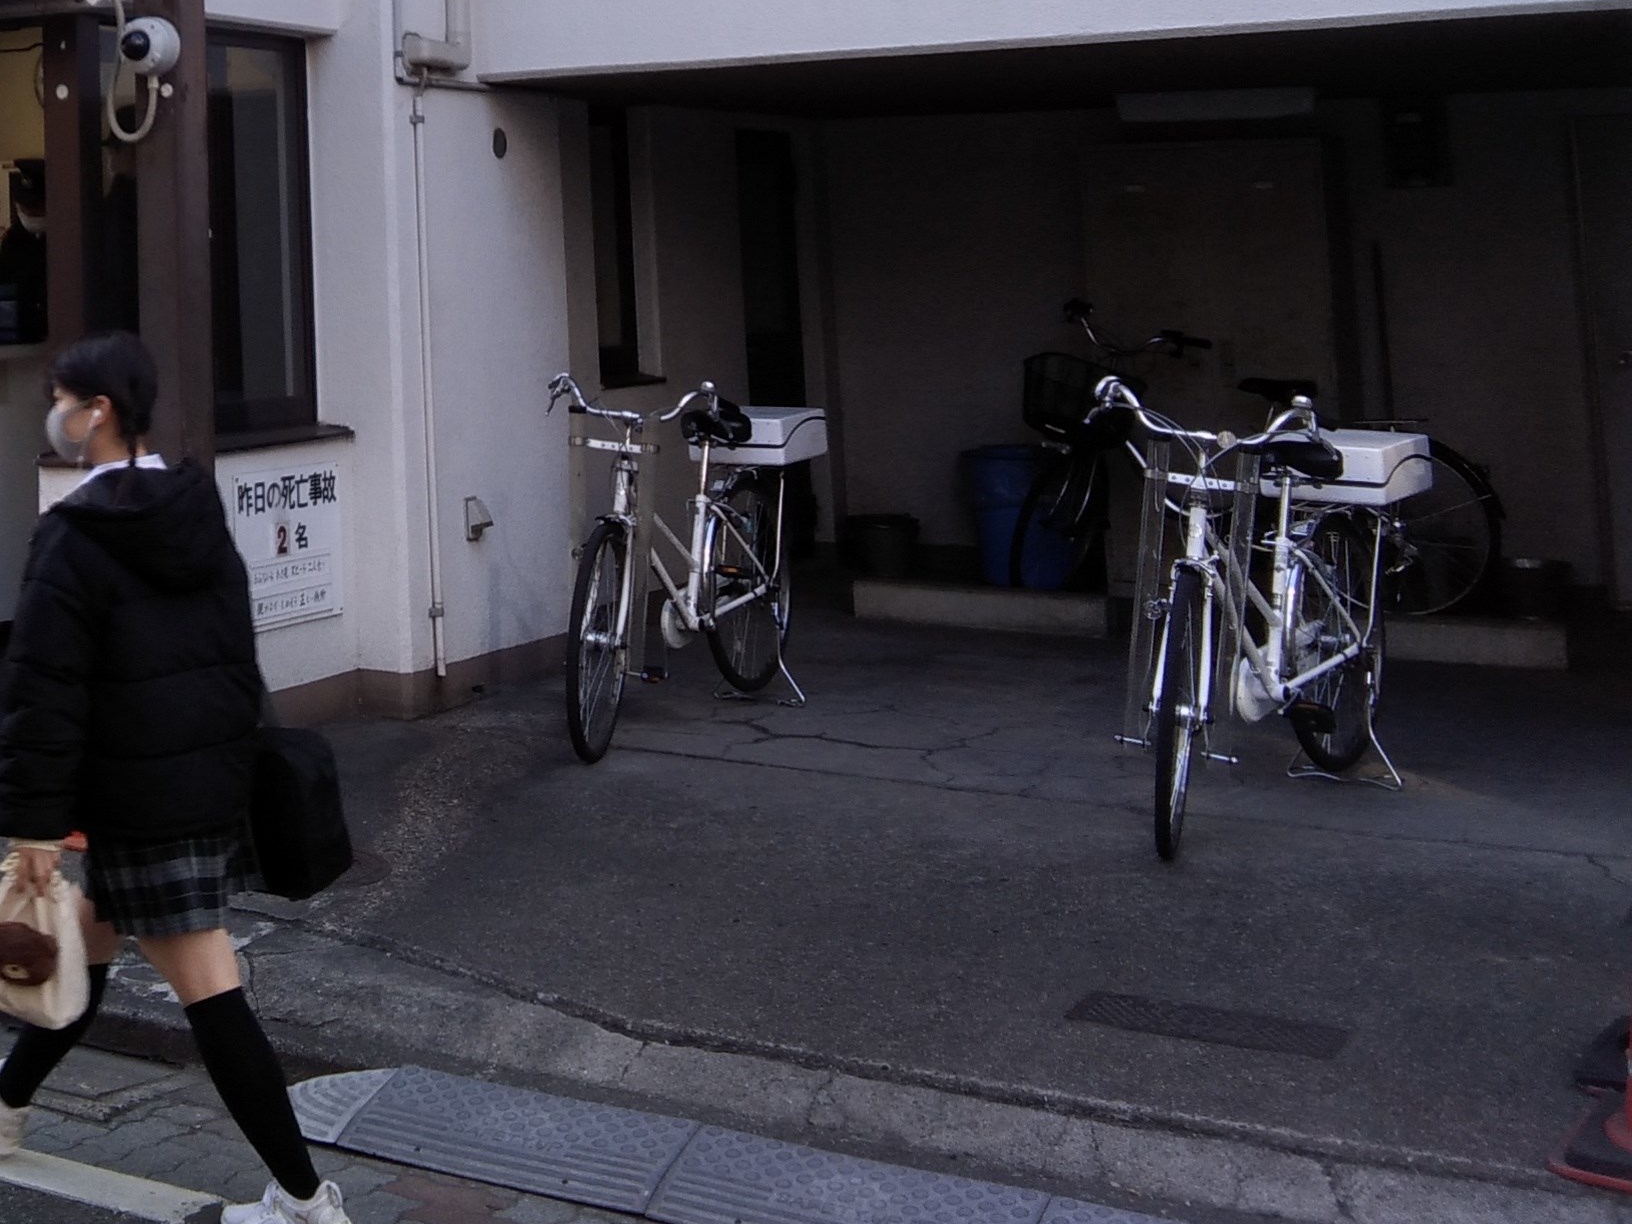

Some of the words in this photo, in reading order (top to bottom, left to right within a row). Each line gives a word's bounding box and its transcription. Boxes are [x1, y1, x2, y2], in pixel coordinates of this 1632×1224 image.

[237, 470, 337, 517] 昨日の死亡事故
[277, 525, 288, 554] 2
[294, 522, 309, 549] 名
